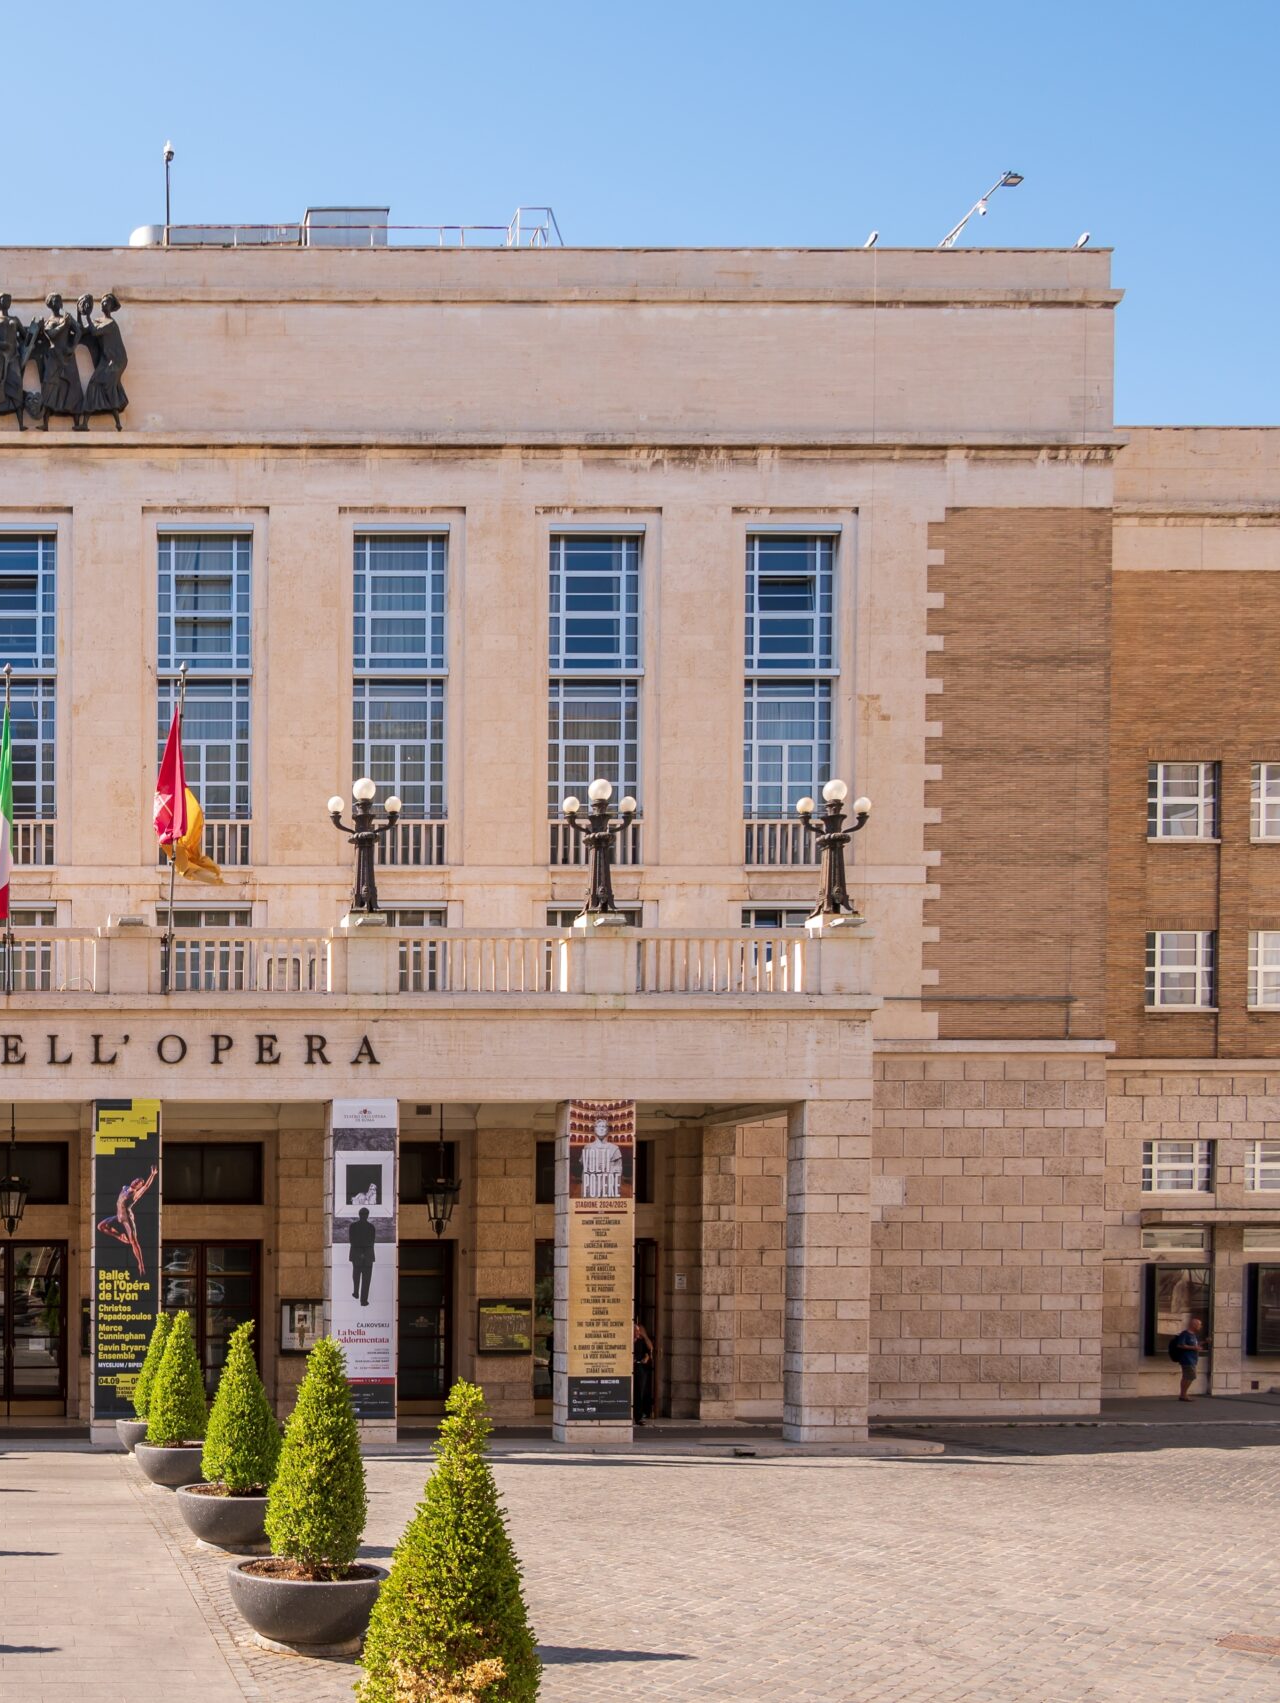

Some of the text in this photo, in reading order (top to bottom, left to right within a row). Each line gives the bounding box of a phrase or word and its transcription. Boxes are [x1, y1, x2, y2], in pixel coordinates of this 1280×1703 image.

[582, 1149, 610, 1172] VOLTI
[583, 1173, 621, 1197] POTERE
[99, 1270, 130, 1280] Ballet
[99, 1280, 150, 1292] de l'Opéra
[99, 1290, 138, 1302] de Lyon
[99, 1312, 152, 1321] Papadopoulos
[99, 1332, 145, 1341] Cunningham
[121, 1344, 146, 1352] Bryars
